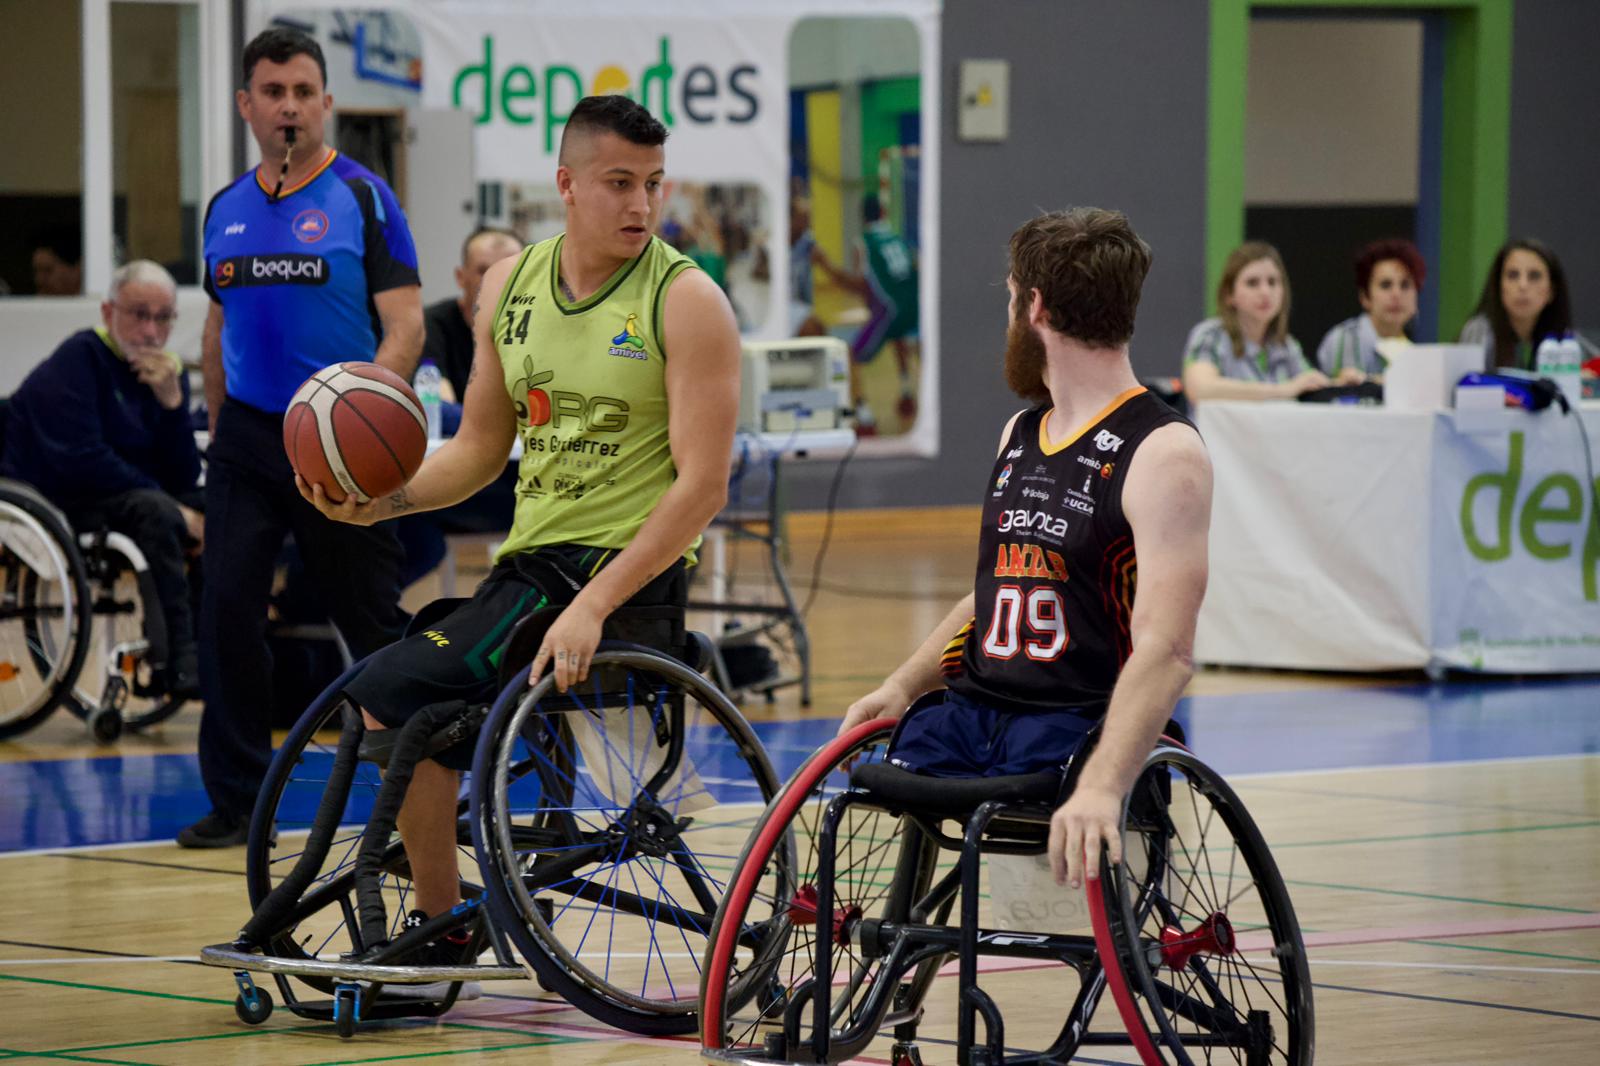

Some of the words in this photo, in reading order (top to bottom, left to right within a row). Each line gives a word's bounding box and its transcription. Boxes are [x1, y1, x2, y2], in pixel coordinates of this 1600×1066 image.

[252, 258, 322, 279] bequal
[503, 309, 532, 345] 14
[550, 435, 620, 456] Giérrez
[982, 584, 1070, 662] 09
